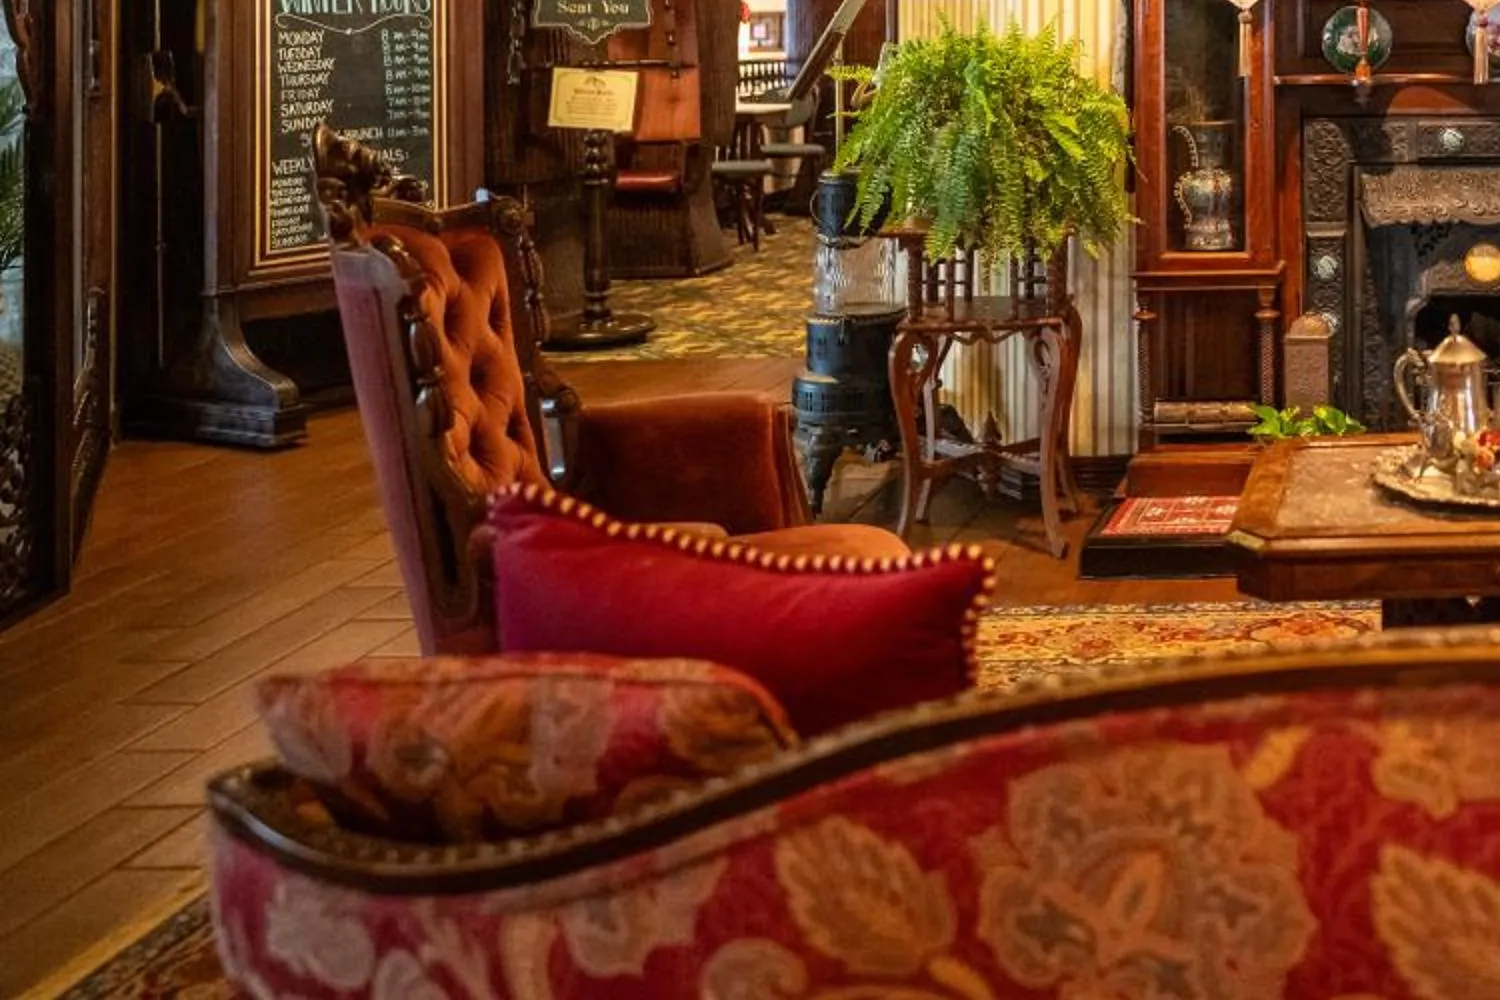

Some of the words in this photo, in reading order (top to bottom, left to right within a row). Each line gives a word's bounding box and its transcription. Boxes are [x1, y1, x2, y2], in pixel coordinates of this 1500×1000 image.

[601, 0, 629, 14] You
[278, 30, 325, 46] MONDAY
[278, 46, 322, 61] TUESDAY
[277, 57, 336, 73] WEDNESDAY
[279, 71, 330, 88] THURSDAY
[281, 87, 321, 101] FRIDAY
[280, 99, 335, 117] SATURDAY
